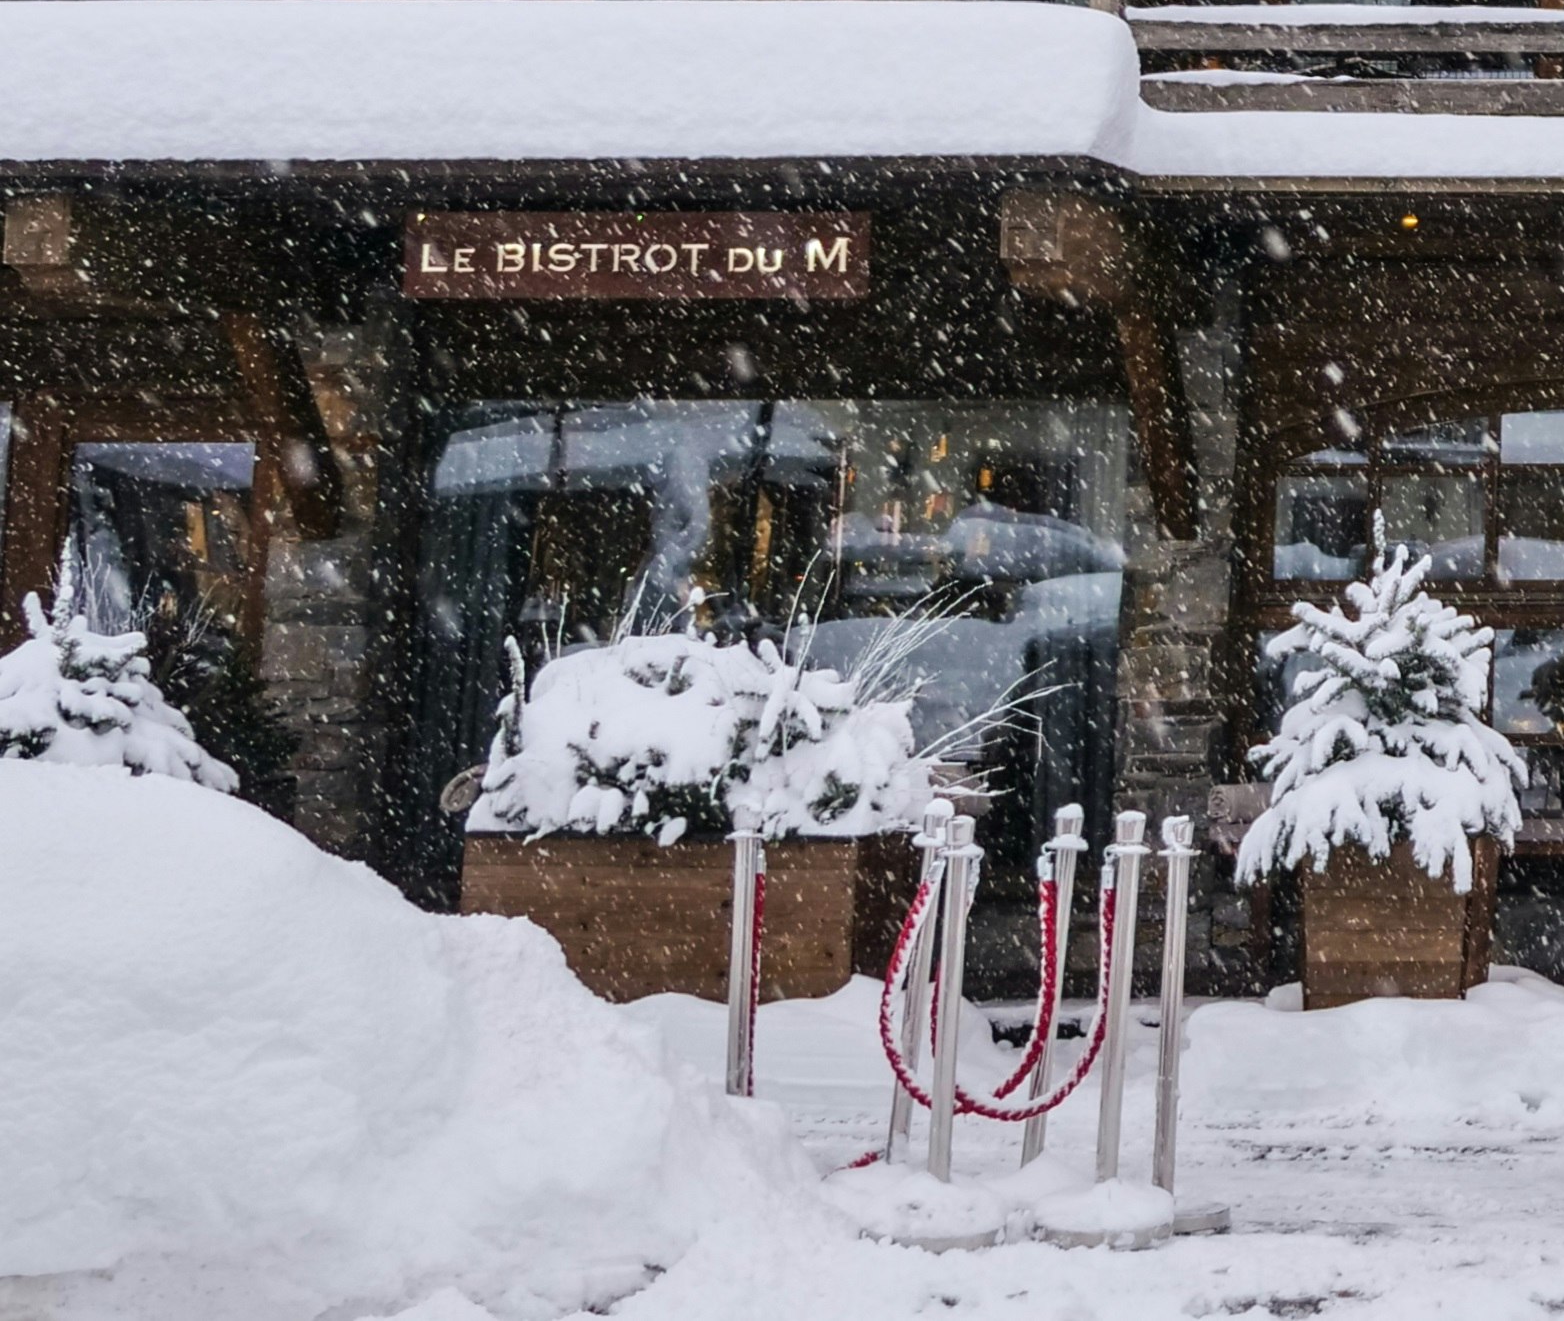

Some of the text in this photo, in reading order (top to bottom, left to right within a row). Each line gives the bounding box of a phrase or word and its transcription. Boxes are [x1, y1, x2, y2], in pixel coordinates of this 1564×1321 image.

[496, 243, 709, 273] BISTROT
[728, 248, 782, 273] DU
[807, 237, 849, 273] M
